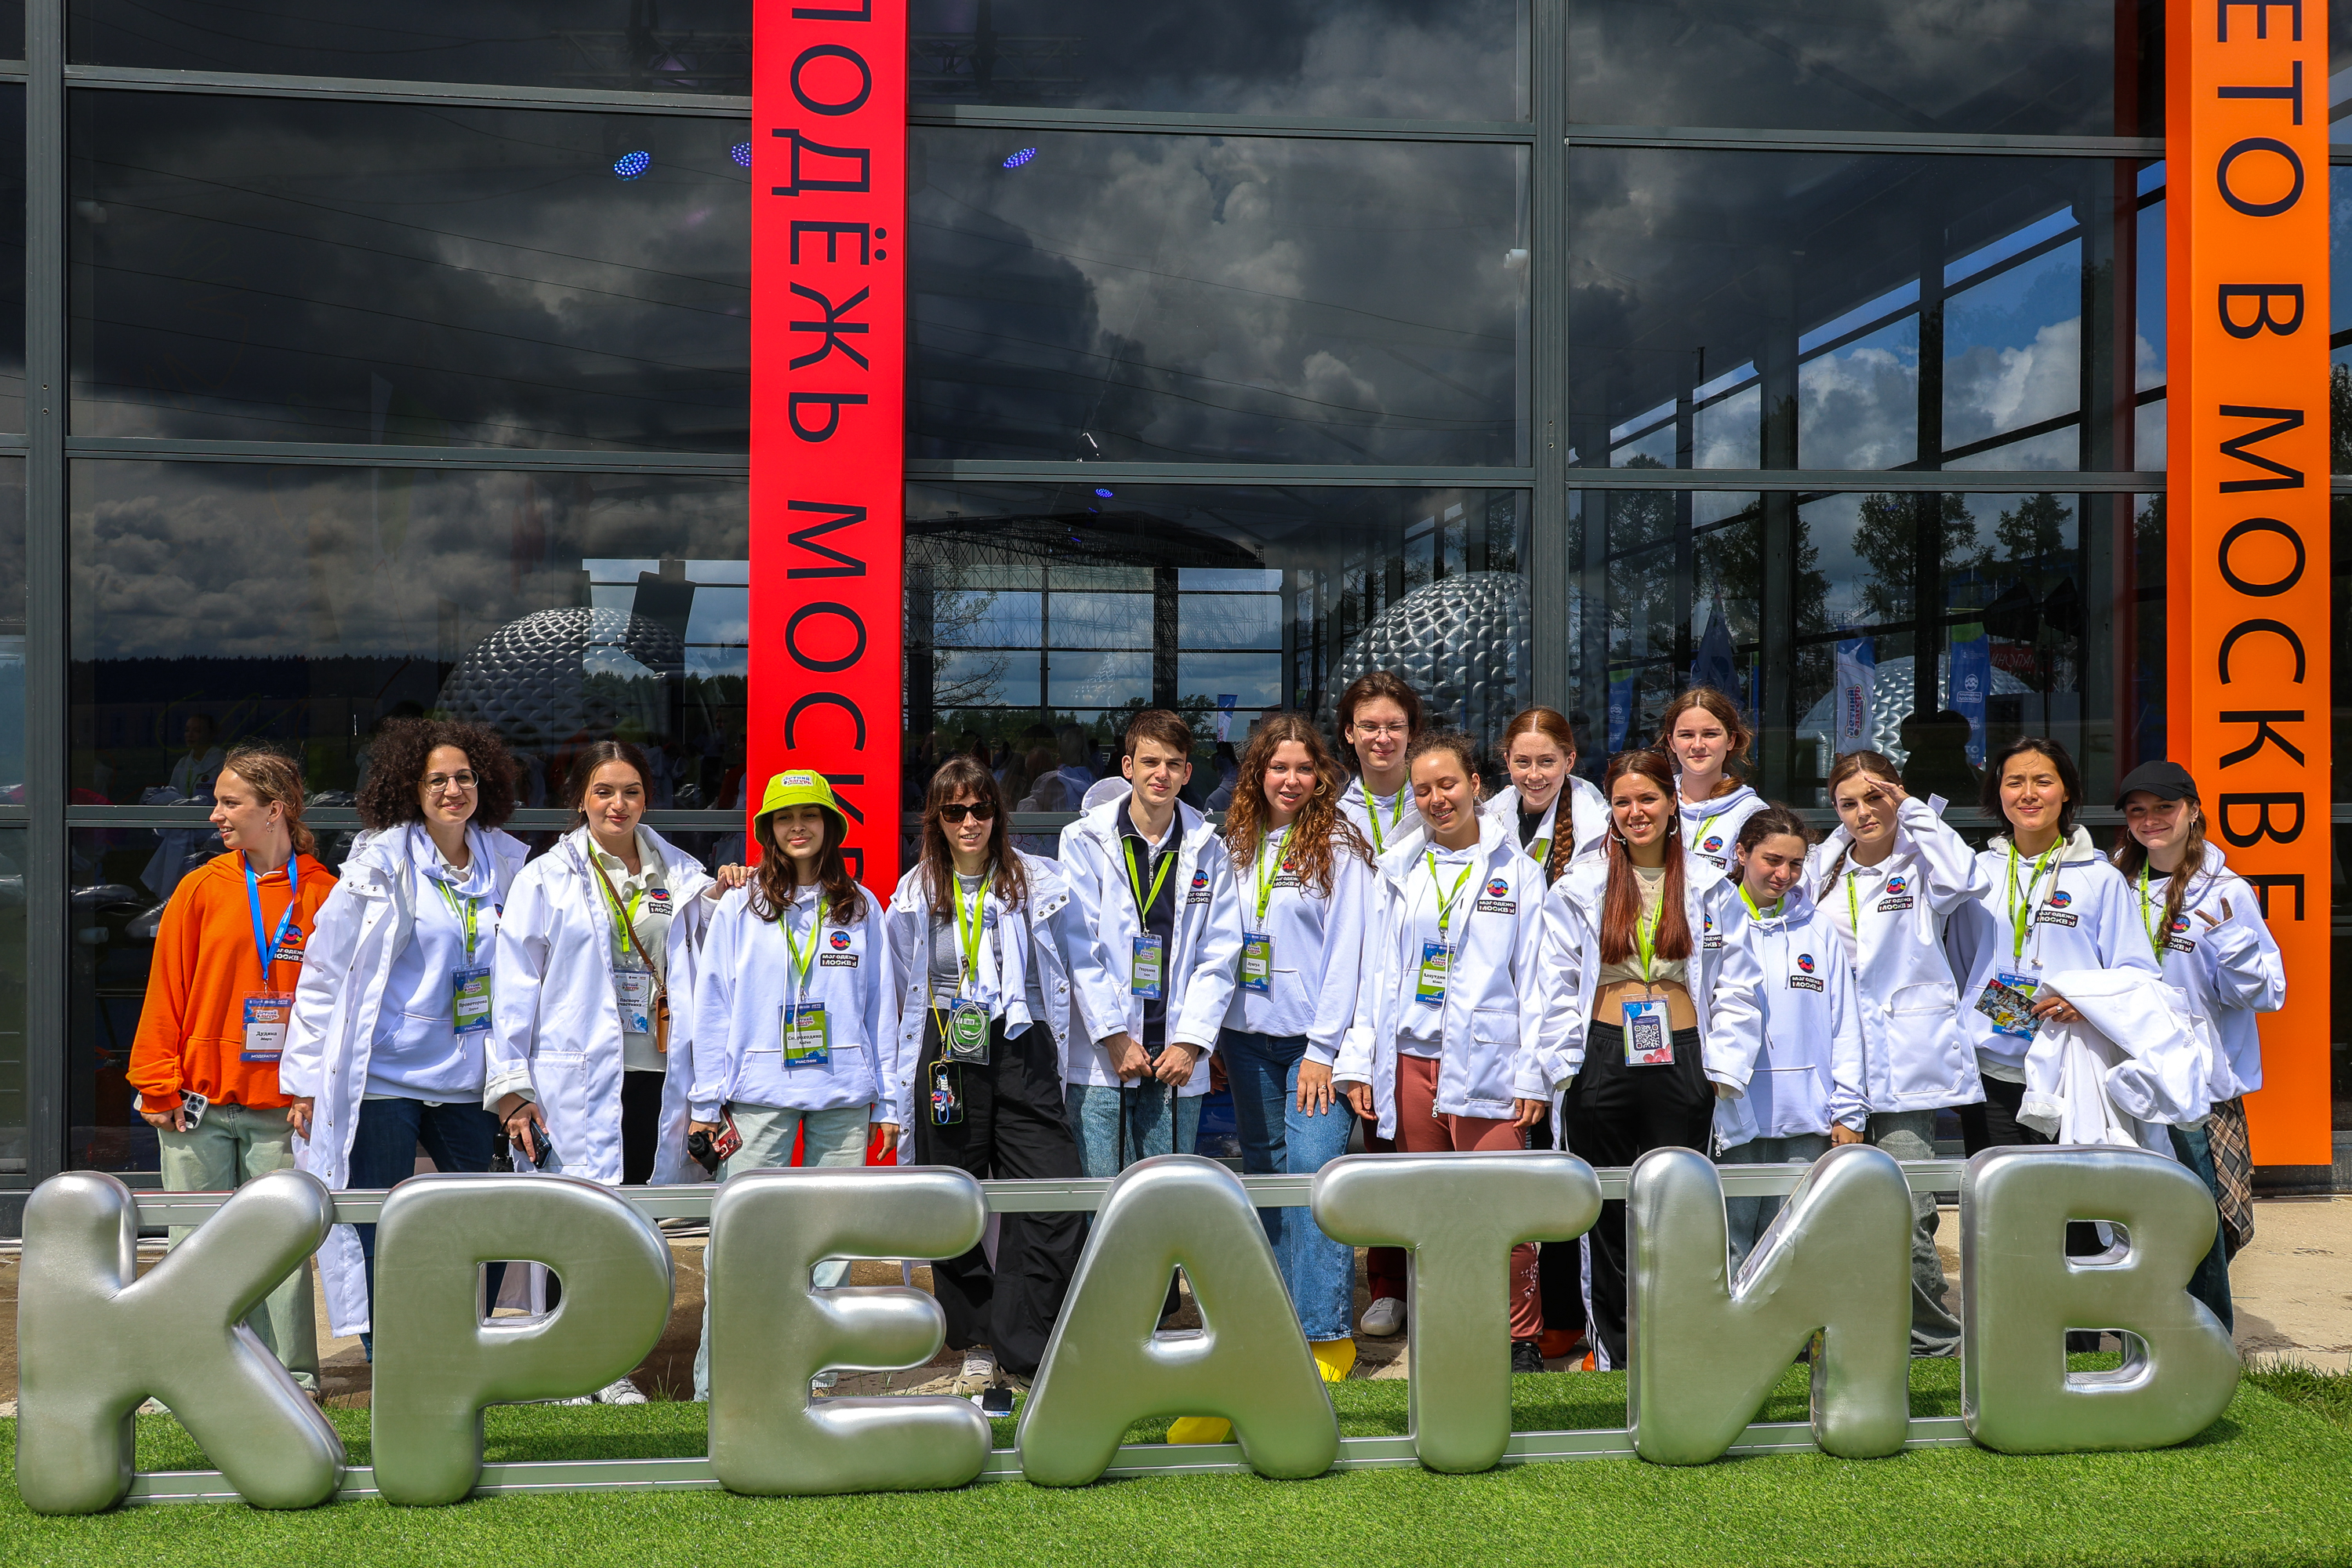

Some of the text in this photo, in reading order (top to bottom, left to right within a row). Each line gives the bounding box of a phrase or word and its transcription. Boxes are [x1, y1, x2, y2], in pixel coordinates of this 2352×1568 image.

[2218, 284, 2305, 339] В
[1479, 906, 1515, 914] МОСКВЫ
[1878, 902, 1912, 911] МОСКВЫ
[1792, 982, 1822, 991] МОСКВЫ
[15, 1143, 2241, 1515] КРЕАТИВ
